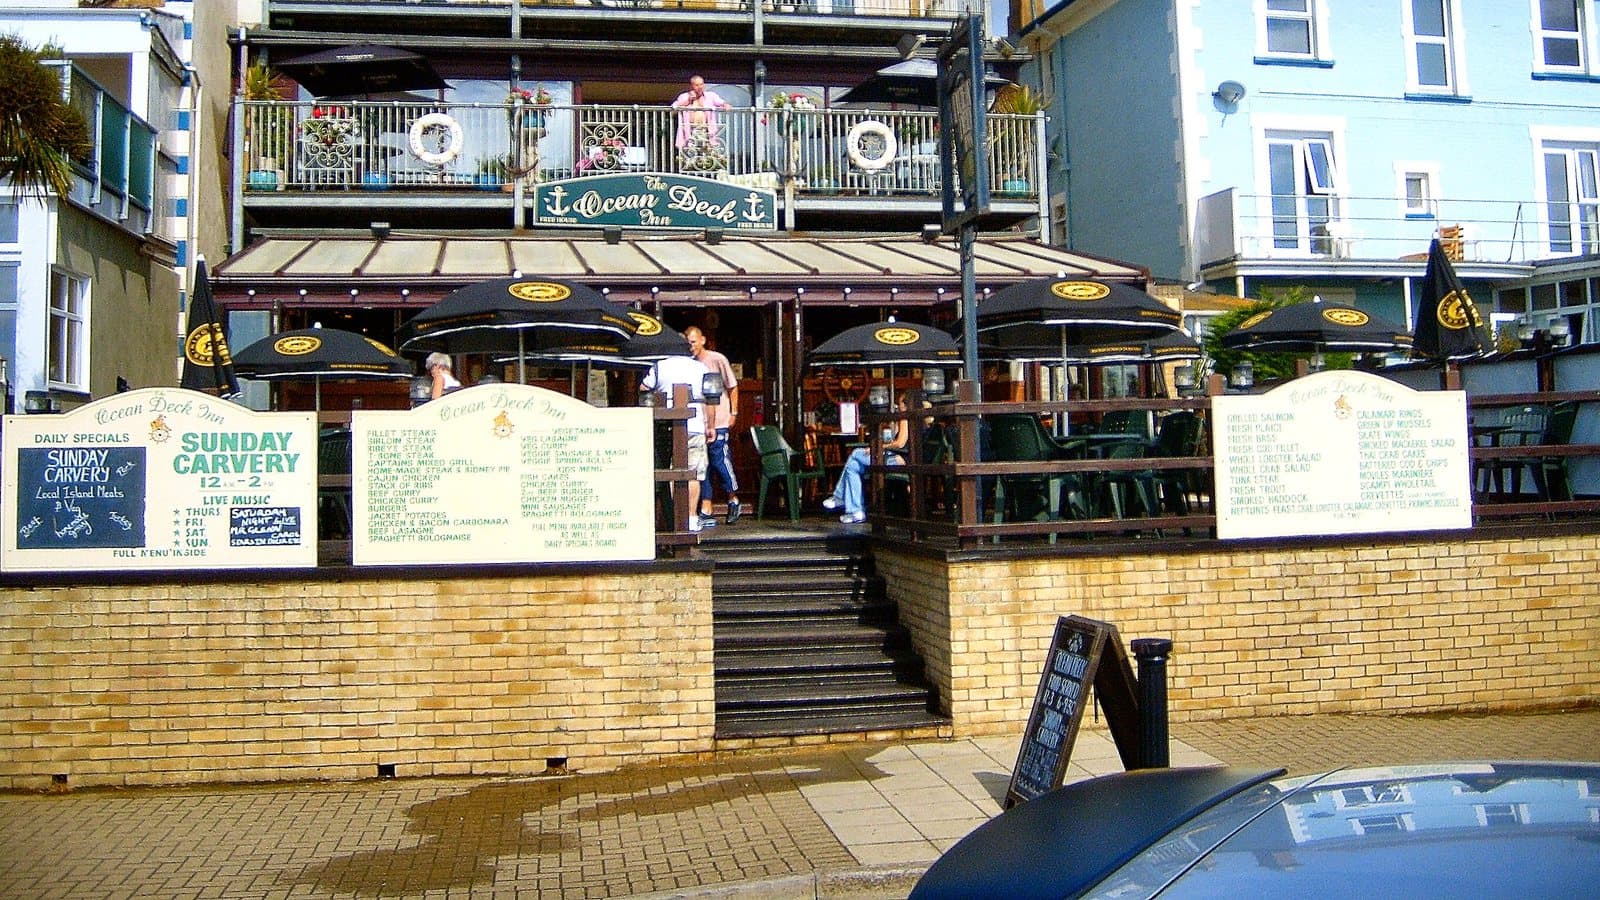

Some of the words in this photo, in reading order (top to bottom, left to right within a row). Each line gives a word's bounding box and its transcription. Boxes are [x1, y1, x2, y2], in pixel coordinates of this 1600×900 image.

[644, 176, 668, 190] The
[573, 191, 660, 218] Ocean
[667, 185, 737, 223] Deck
[639, 209, 672, 226] Inn
[97, 405, 142, 425] Ocean
[149, 396, 192, 415] Deck
[198, 404, 225, 424] Inn
[440, 401, 486, 421] Ocean
[490, 393, 533, 408] Deck
[541, 401, 566, 419] Inn
[35, 434, 68, 443] DAILY
[73, 433, 130, 442] SPECIALS
[181, 432, 292, 452] SUNDAY
[47, 449, 108, 467] SUNDAY
[173, 454, 300, 474] CARVERY
[45, 467, 110, 482] CARVERY
[36, 486, 60, 499] Local
[63, 486, 94, 498] Island
[97, 485, 124, 498] Meats
[203, 496, 228, 505] LIVE
[232, 495, 270, 504] MUSIC
[232, 509, 286, 518] SATURDAY
[368, 535, 415, 543] SPAGHETTI
[173, 549, 207, 557] INSIDE
